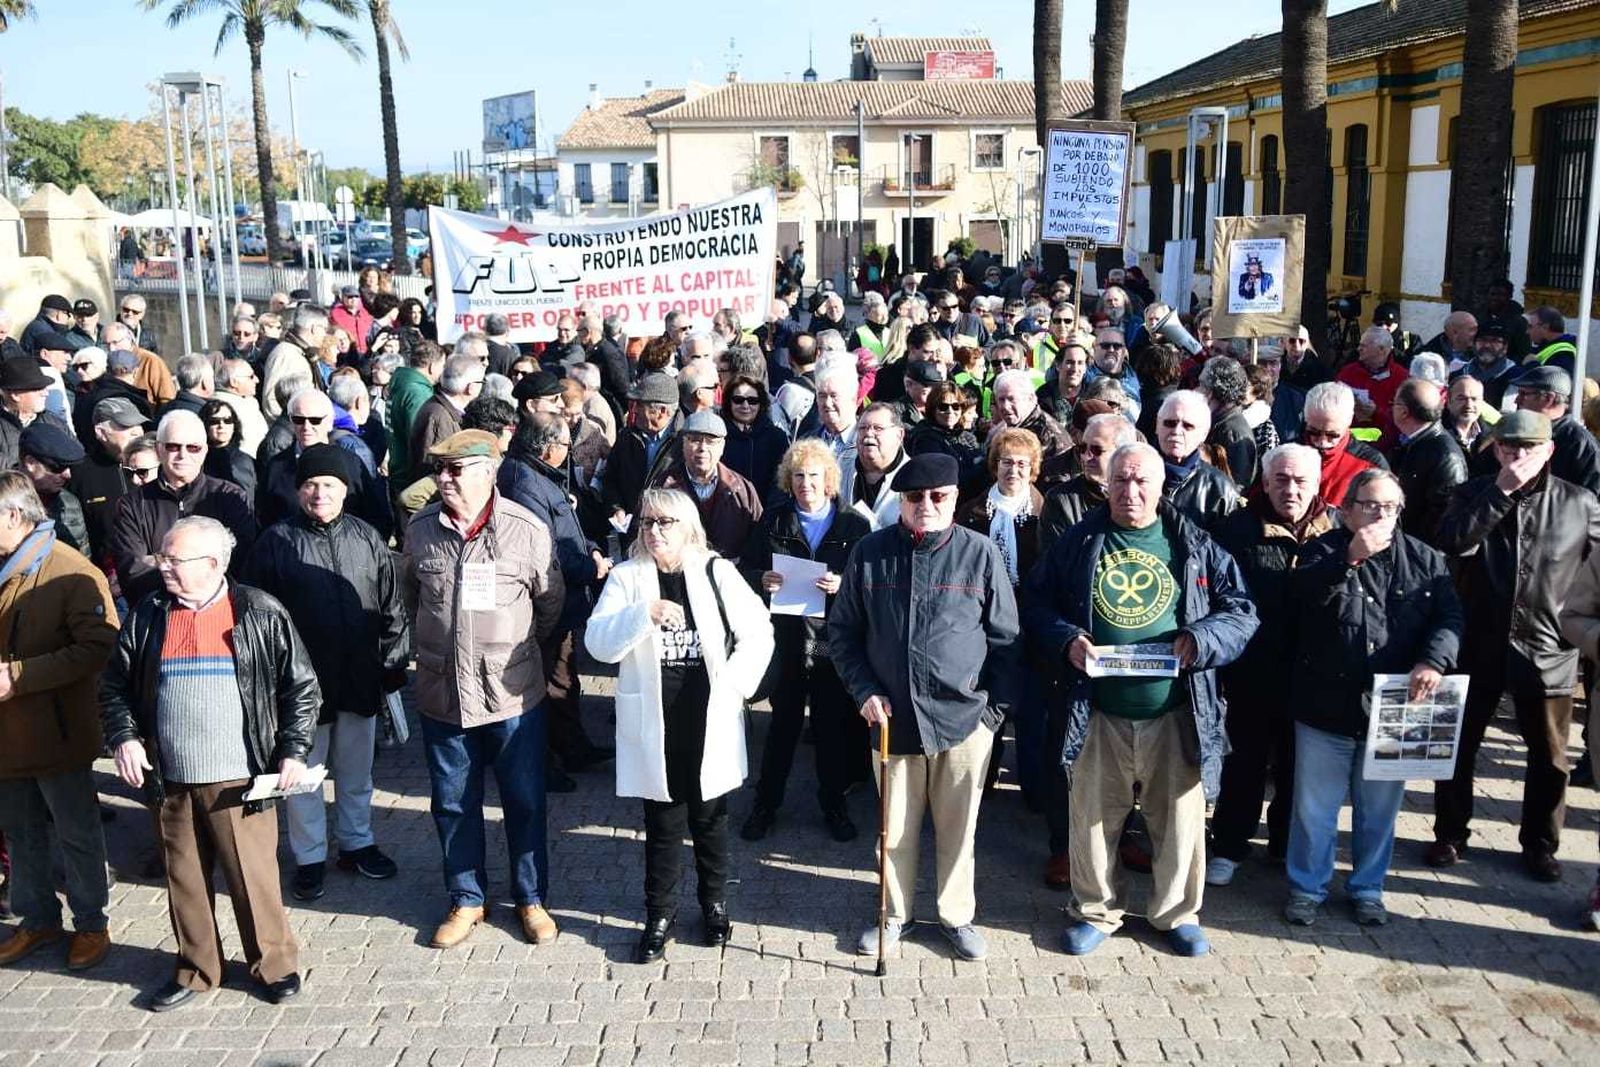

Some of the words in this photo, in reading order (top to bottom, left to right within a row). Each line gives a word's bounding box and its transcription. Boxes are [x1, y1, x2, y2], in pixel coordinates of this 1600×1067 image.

[1053, 135, 1091, 149] NINGUNA
[1063, 149, 1081, 160] POR
[1053, 163, 1067, 172] DE
[1074, 162, 1110, 176] 1000
[1055, 173, 1113, 188] SUBIENDO
[1075, 184, 1096, 193] LOS
[1052, 191, 1119, 204] IMPUESTOS
[1049, 208, 1086, 219] BANCOS
[1079, 202, 1087, 211] A
[548, 216, 682, 248] CONSTRUYENDO
[687, 203, 763, 233] NUESTRA
[1048, 221, 1110, 234] MONOPOLIOS
[582, 246, 644, 271] PROPIA
[452, 252, 581, 294] FUP
[575, 277, 646, 300] FRENTE
[652, 273, 675, 293] AL
[454, 311, 536, 332] “POER
[543, 303, 630, 327] OBRO
[638, 302, 651, 321] Y
